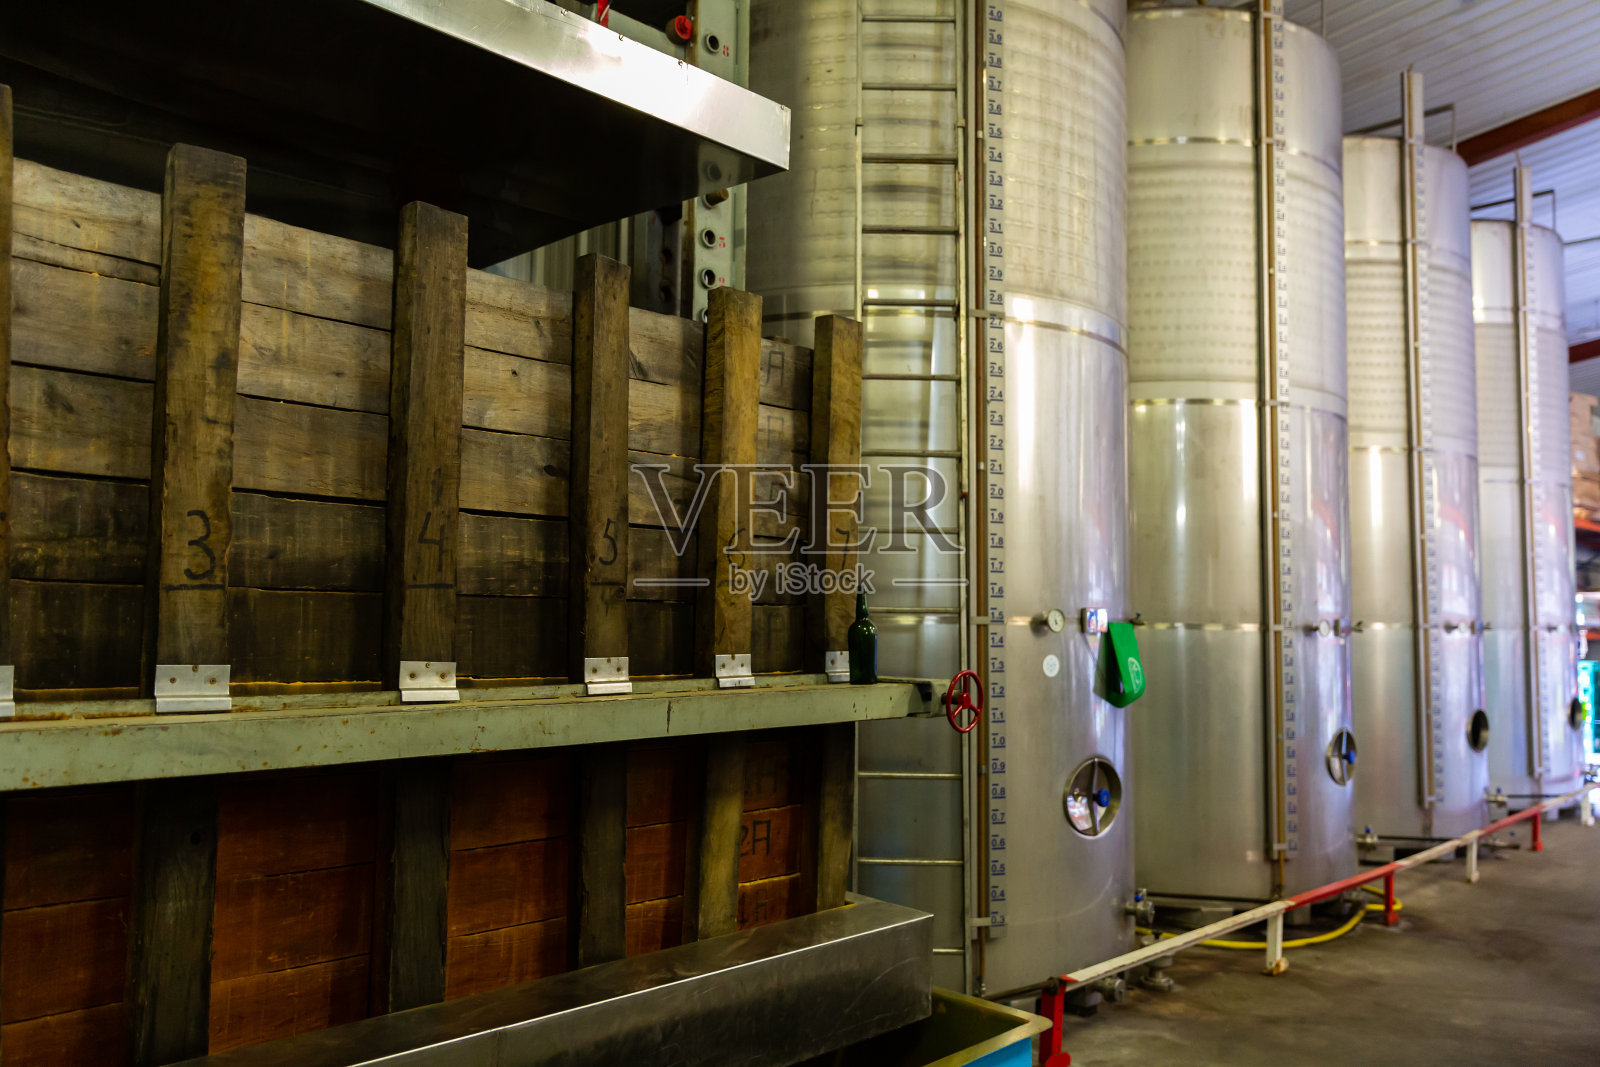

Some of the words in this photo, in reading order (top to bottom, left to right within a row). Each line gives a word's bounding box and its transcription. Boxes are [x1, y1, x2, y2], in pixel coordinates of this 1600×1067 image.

[183, 509, 217, 581] 3
[418, 511, 446, 573] 4
[598, 518, 618, 566] 5
